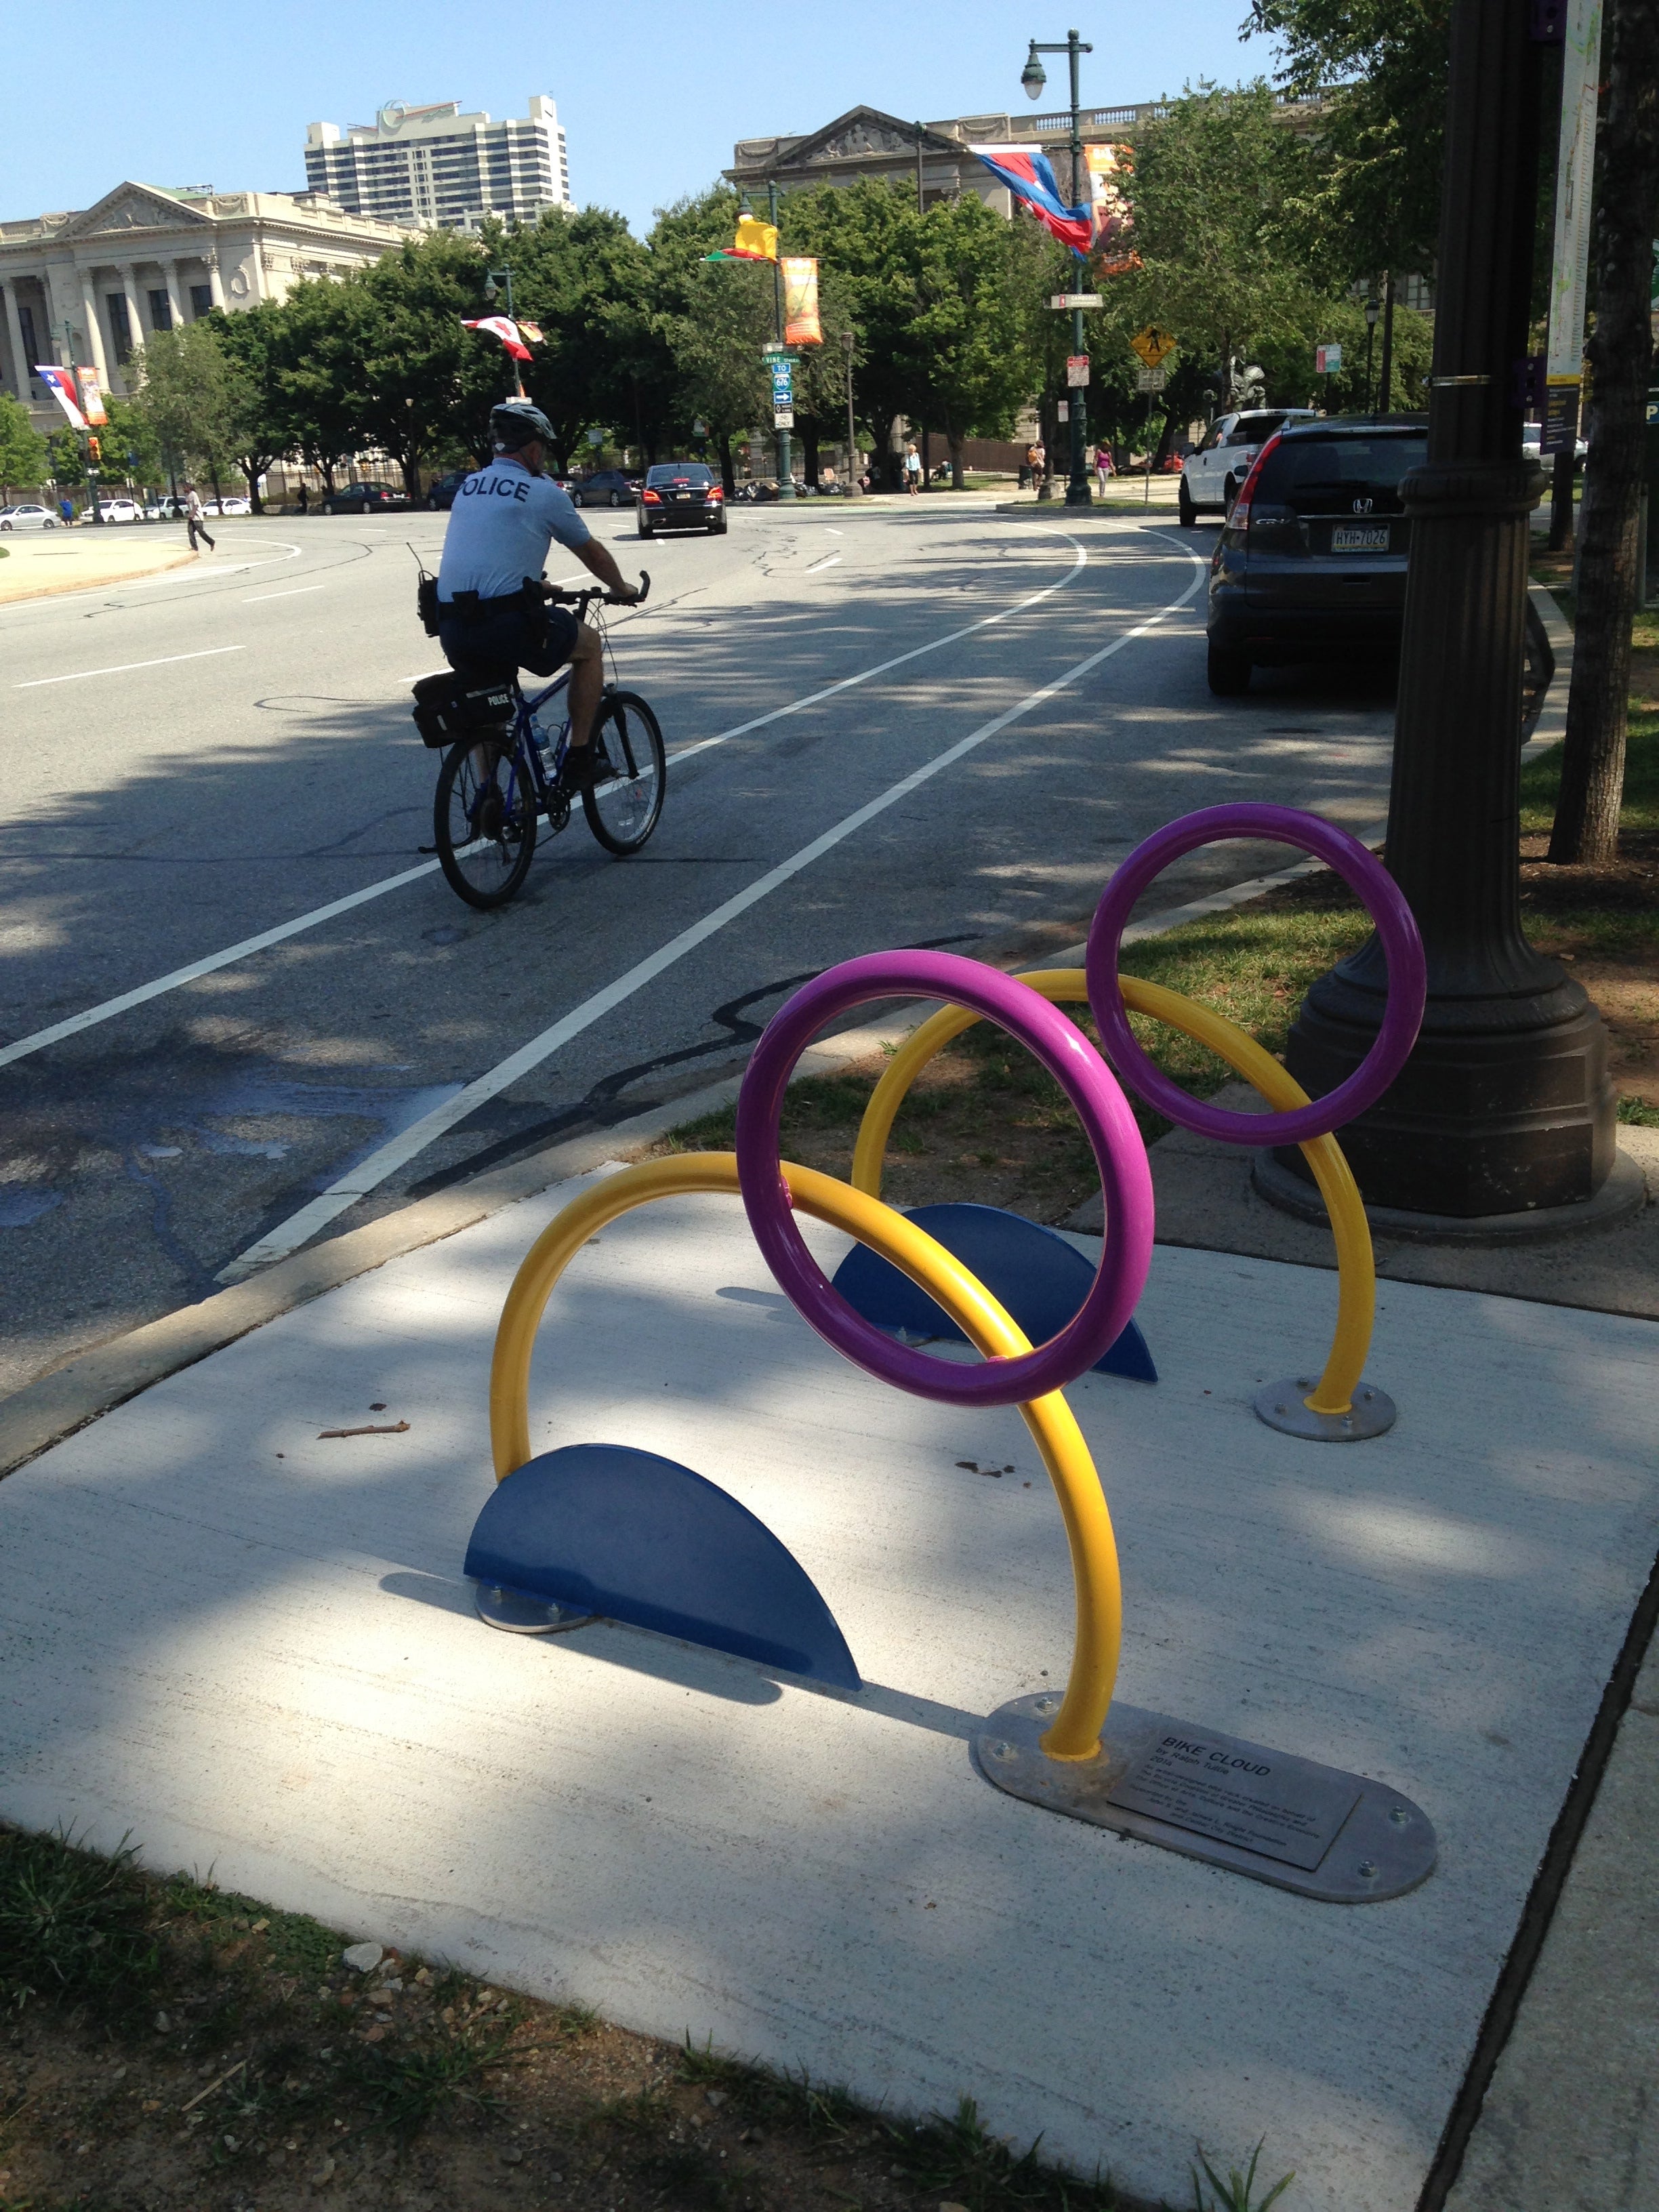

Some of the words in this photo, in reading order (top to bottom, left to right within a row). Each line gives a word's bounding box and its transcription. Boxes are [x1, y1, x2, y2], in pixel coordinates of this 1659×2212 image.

[776, 377, 787, 386] 676
[488, 693, 509, 705] POLICE
[1155, 1747, 1168, 1755] by
[1170, 1752, 1200, 1765] Ralph
[1162, 1737, 1205, 1755] BIKE
[1208, 1751, 1271, 1776] CLOUD
